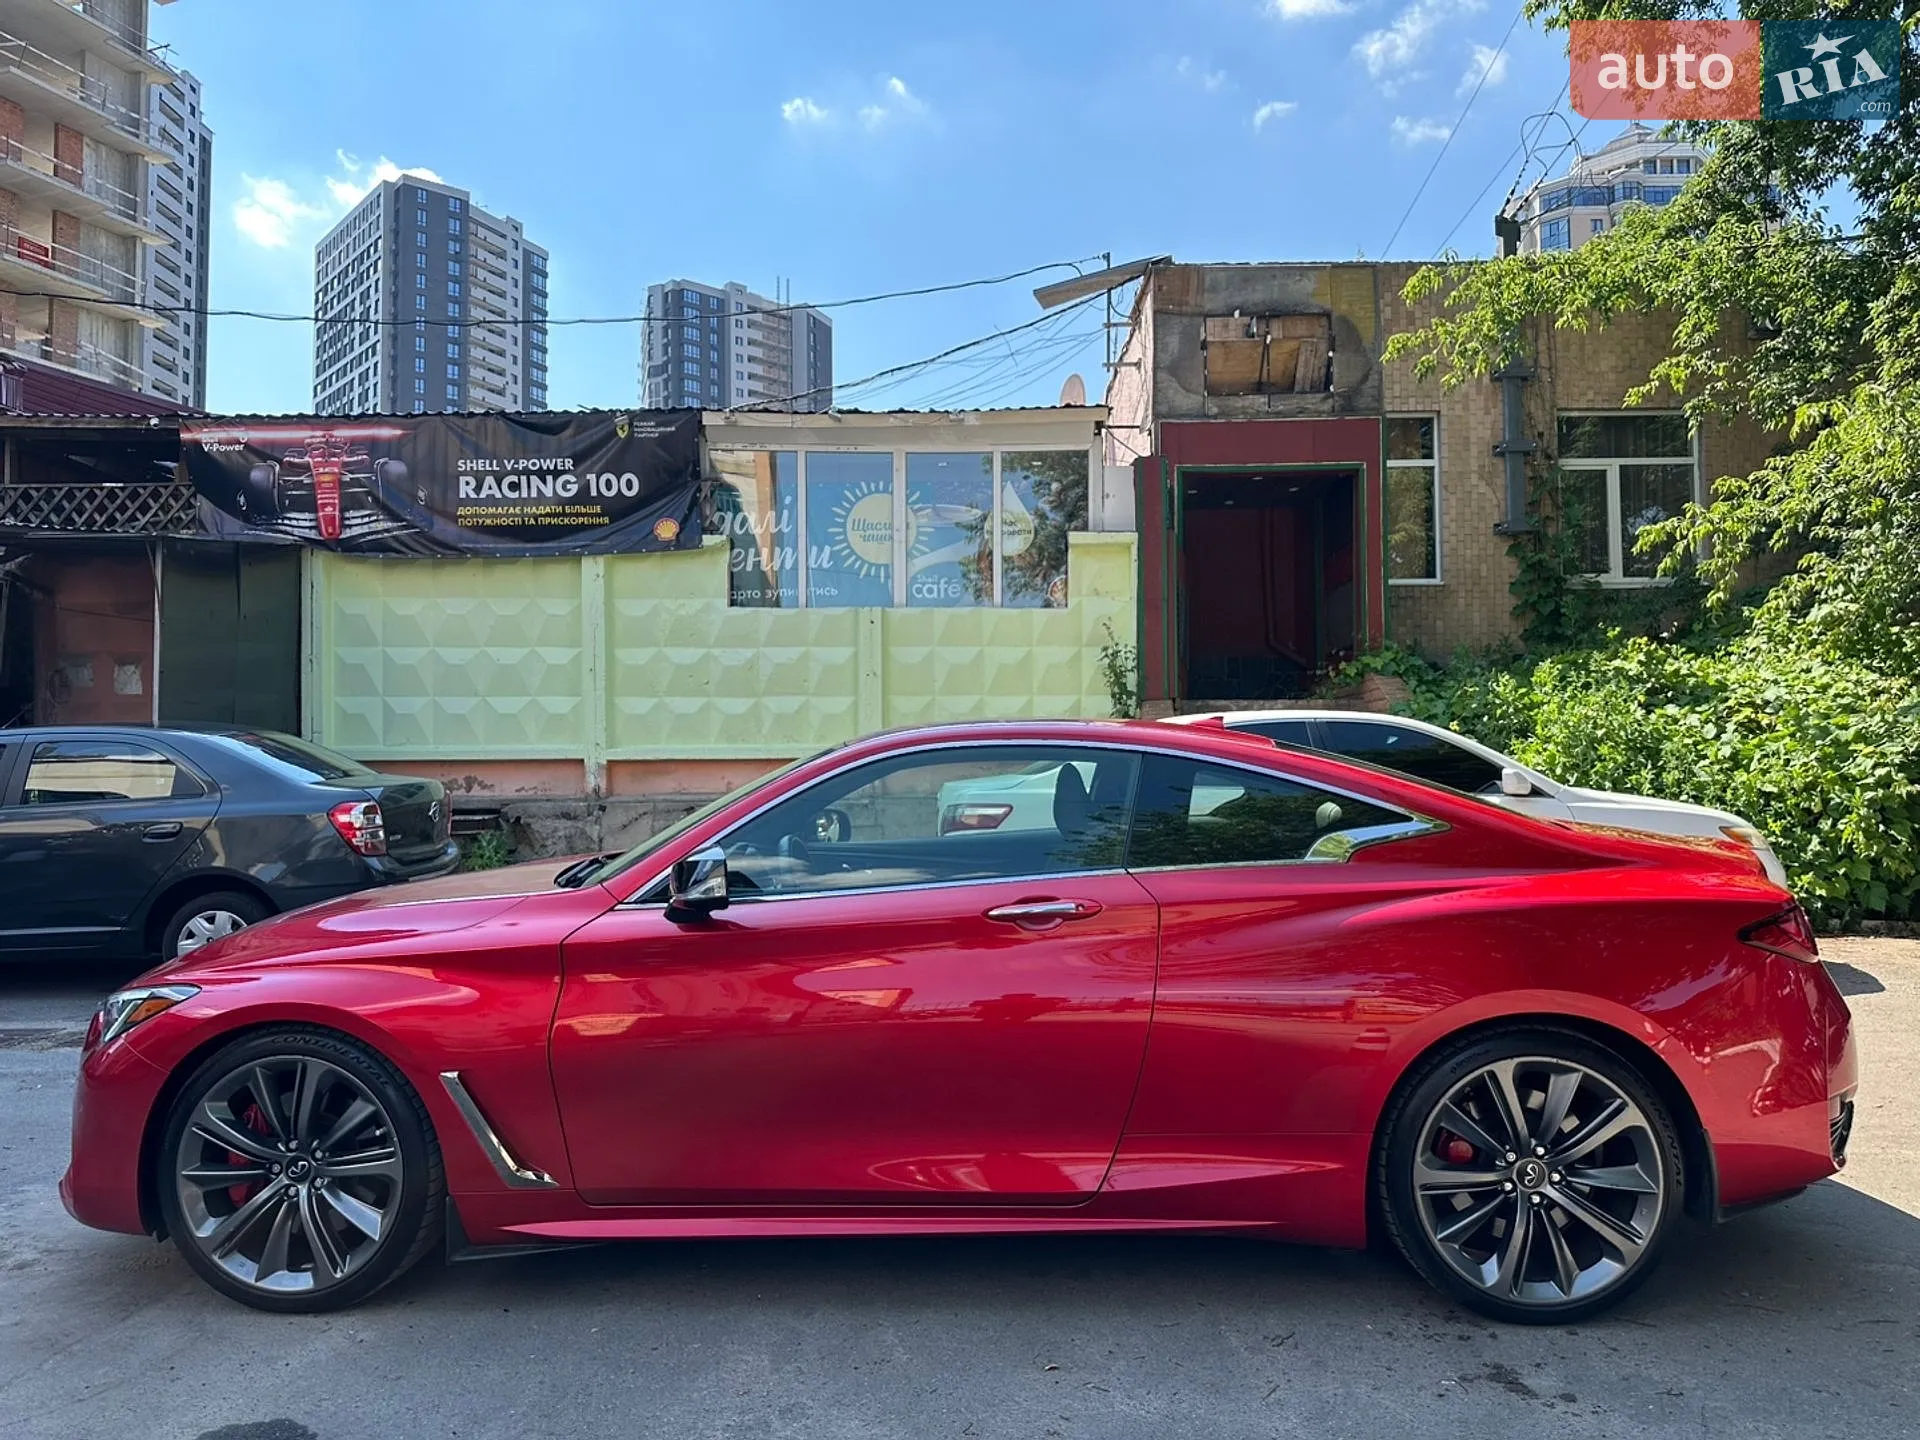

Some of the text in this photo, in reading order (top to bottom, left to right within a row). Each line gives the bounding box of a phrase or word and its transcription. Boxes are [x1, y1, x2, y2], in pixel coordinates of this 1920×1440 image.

[202, 443, 245, 452] V-Power
[457, 458, 574, 471] SHELL V-POWER
[458, 472, 640, 499] RACING 100
[457, 504, 602, 516] ДОПОМАГАЄ НАДАТИ БІЛЬШЕ
[458, 516, 610, 527] ПОТУЖНОСТІ ТА ПРИСКОРЕННЯ
[730, 586, 839, 601] арто зупитись
[912, 576, 961, 599] café
[271, 1034, 390, 1087] CONTINENTAL
